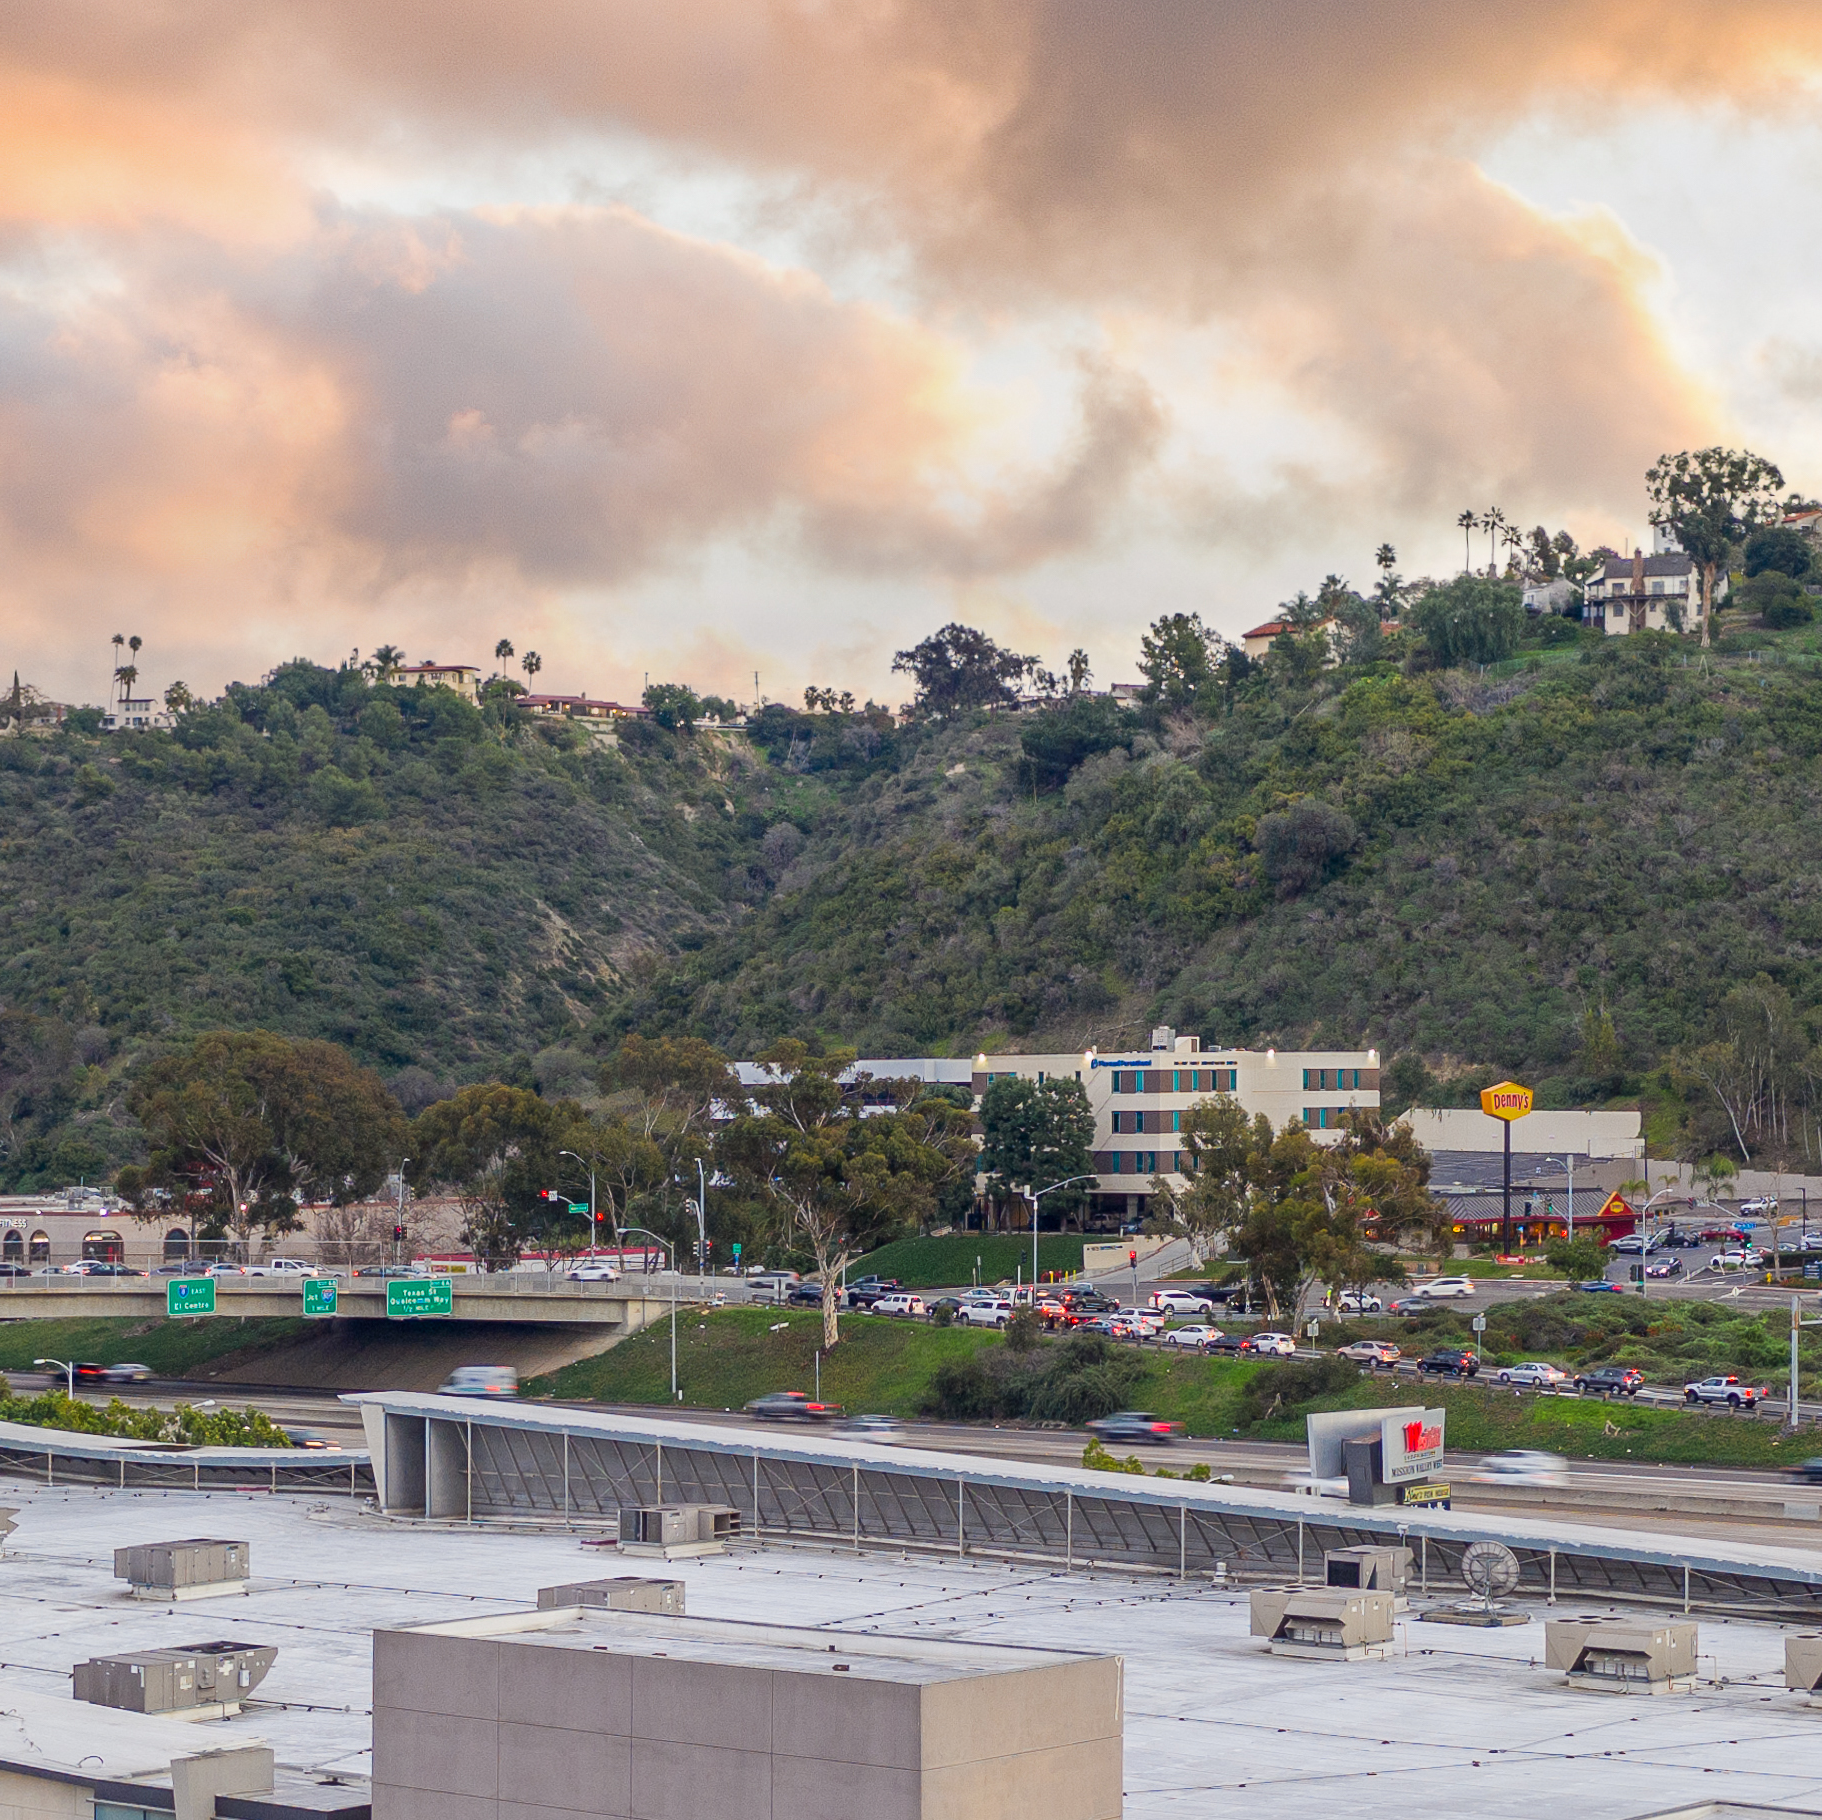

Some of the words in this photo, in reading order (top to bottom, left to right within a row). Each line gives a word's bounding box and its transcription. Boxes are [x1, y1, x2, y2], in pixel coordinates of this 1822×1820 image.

[1493, 1092, 1530, 1111] Denny's
[390, 1297, 430, 1305] Qualcomm
[433, 1296, 449, 1304] Way
[1392, 1465, 1415, 1477] MISSION
